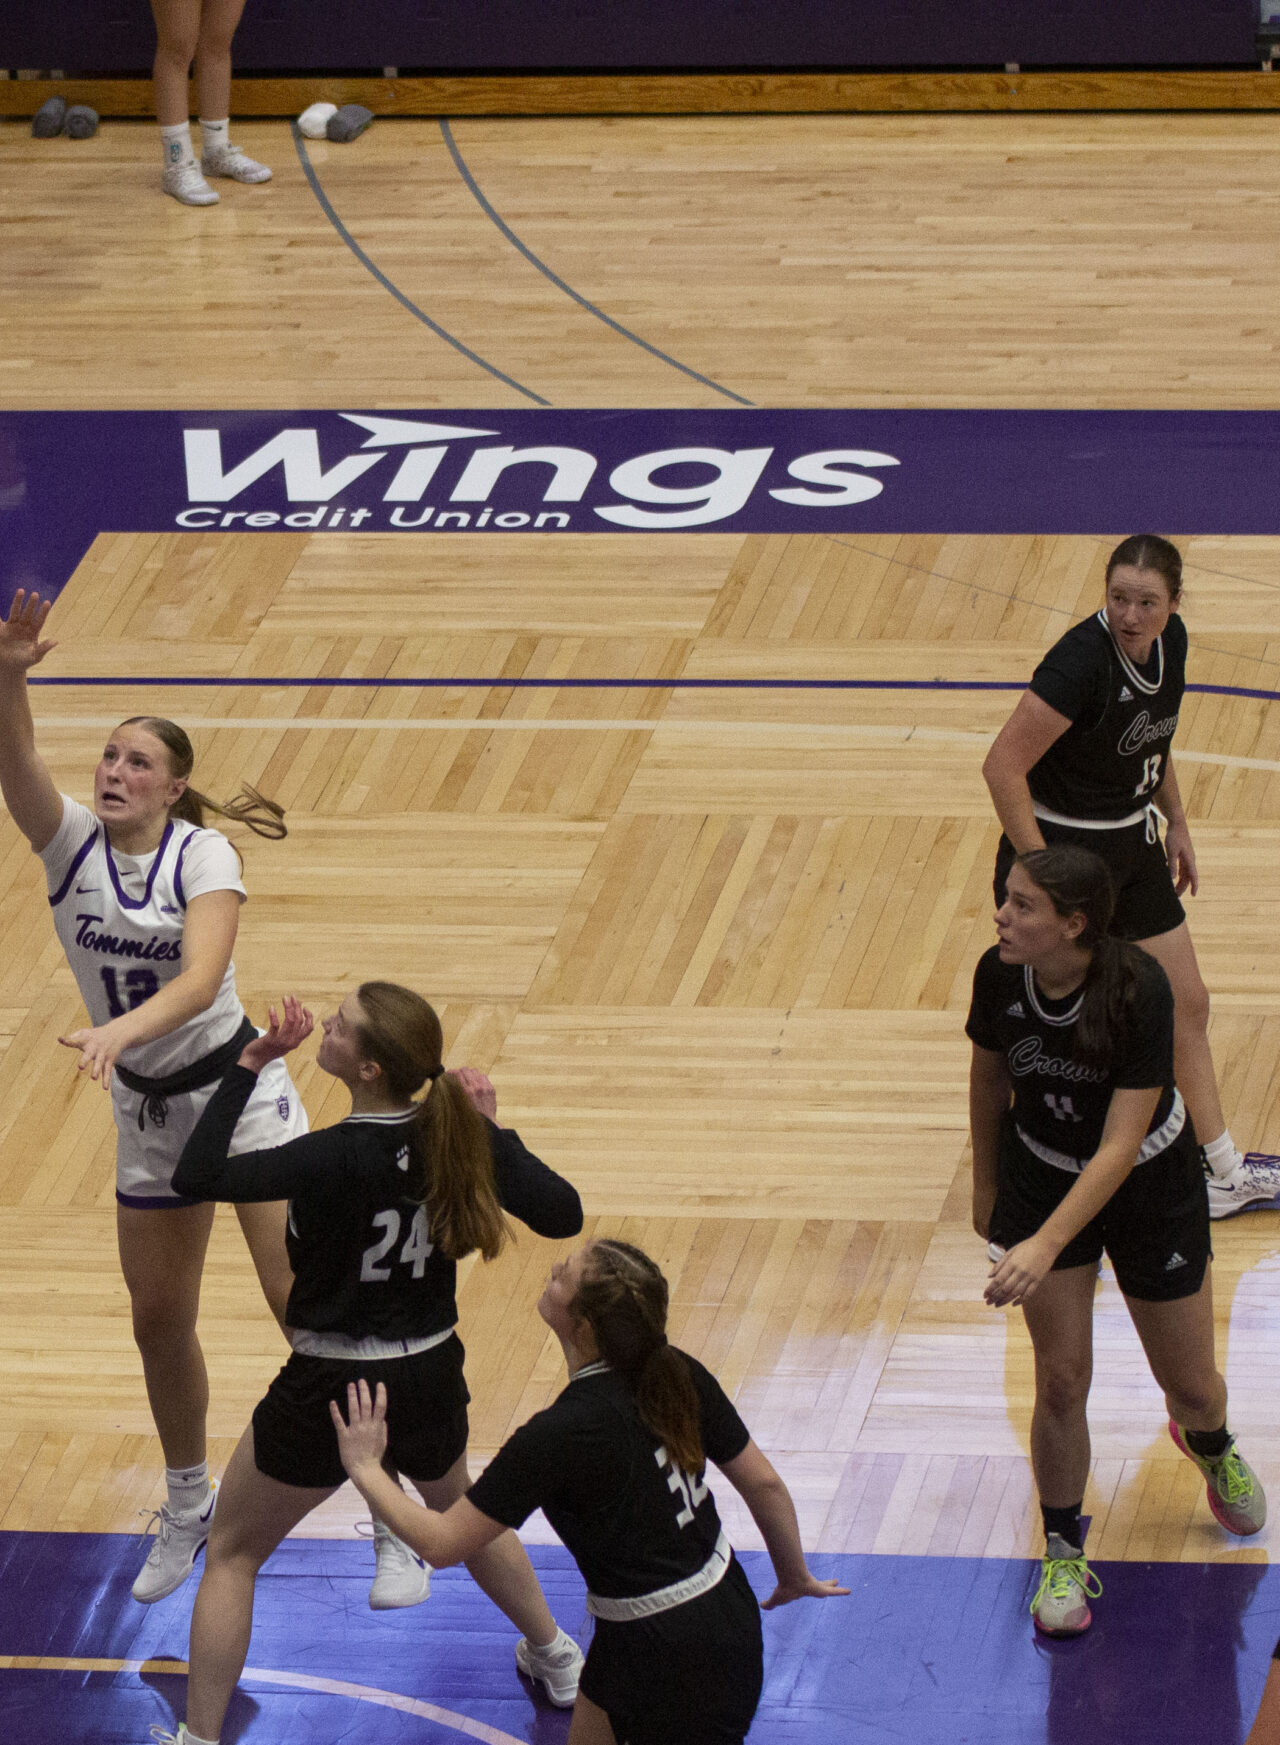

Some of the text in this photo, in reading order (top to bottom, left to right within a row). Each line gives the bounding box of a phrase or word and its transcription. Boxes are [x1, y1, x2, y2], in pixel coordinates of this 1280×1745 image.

[182, 413, 902, 529] Wings
[175, 506, 570, 528] Credit Union
[75, 913, 183, 962] Tommies
[359, 1203, 435, 1282] 24
